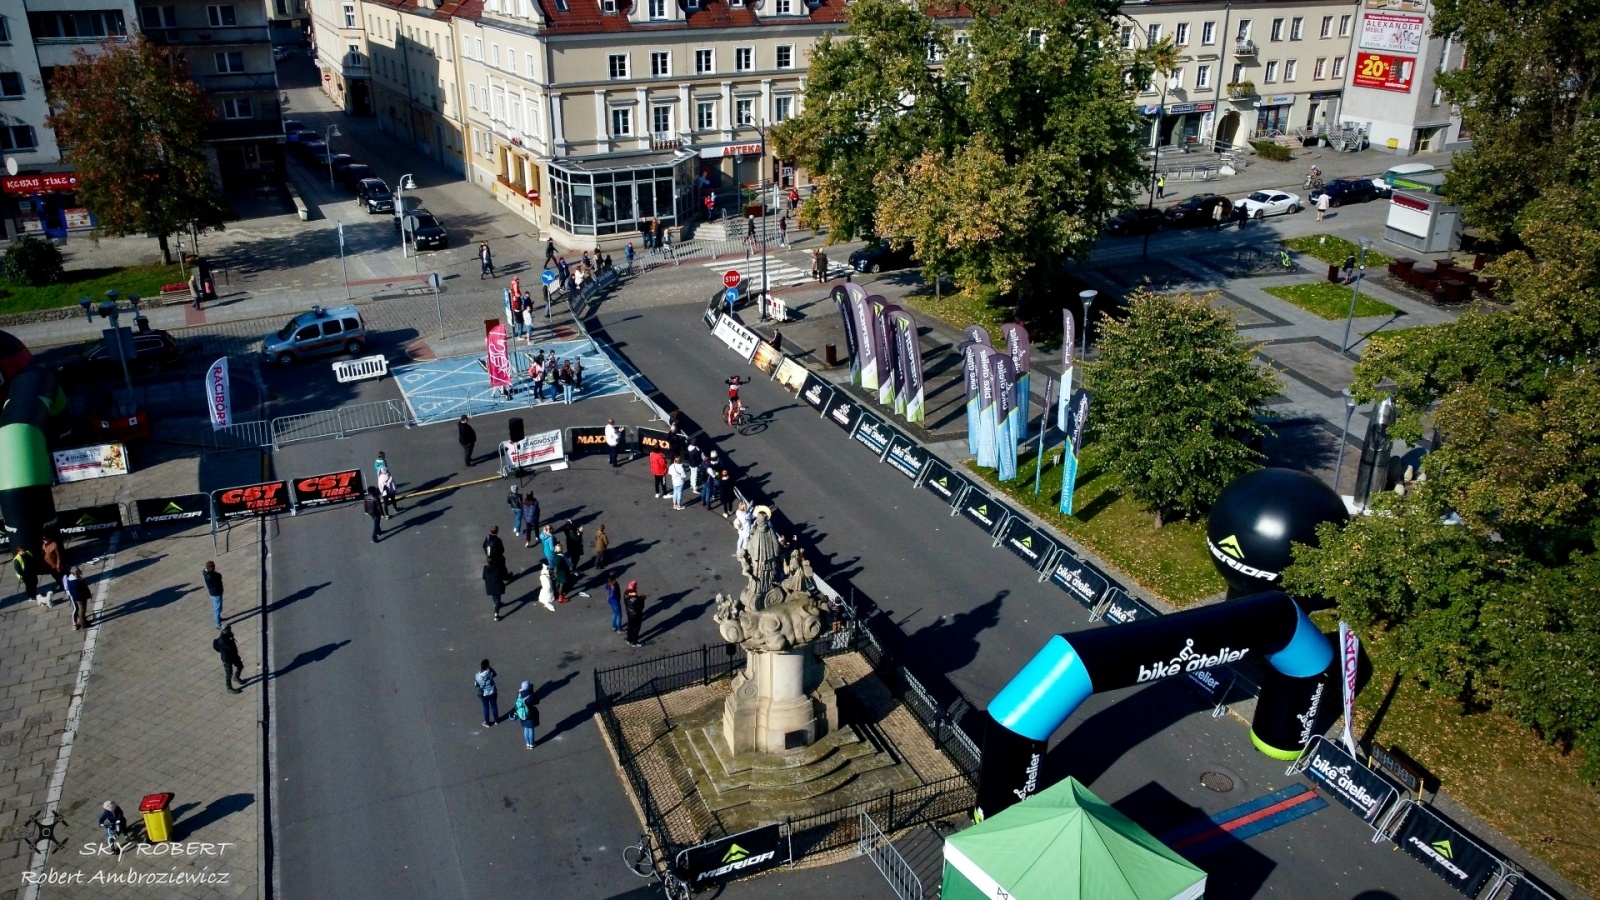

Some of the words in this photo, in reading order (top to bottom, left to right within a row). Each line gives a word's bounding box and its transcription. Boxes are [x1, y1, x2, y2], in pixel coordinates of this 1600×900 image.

[1366, 20, 1420, 30] ALEXANDER
[723, 144, 761, 156] APTEKA
[7, 178, 39, 188] KEBAB
[44, 176, 68, 185] TIME
[725, 275, 739, 283] STOP
[722, 318, 754, 344] LELLEK
[214, 366, 228, 426] RACIBÓRZ
[577, 435, 607, 444] MAXX
[892, 444, 903, 458] bike
[298, 472, 356, 492] CST
[321, 486, 352, 498] TIRES
[222, 483, 282, 504] CST
[246, 498, 277, 509] TIRES
[146, 511, 202, 522] MERIDA
[60, 521, 118, 534] MERIDA
[1010, 538, 1038, 559] MERIDA
[1207, 536, 1278, 581] MERIDA
[1056, 564, 1072, 581] bike
[1072, 576, 1095, 598] atelier
[1109, 603, 1127, 622] bike
[1137, 661, 1181, 682] bike
[1186, 647, 1249, 672] atelier
[1298, 718, 1314, 744] bike
[1310, 682, 1324, 718] atelier
[1026, 753, 1040, 792] atelier
[1312, 755, 1337, 779] bike
[1338, 776, 1376, 807] atelier
[697, 850, 775, 881] MERIDA
[1409, 836, 1468, 880] MERIDA
